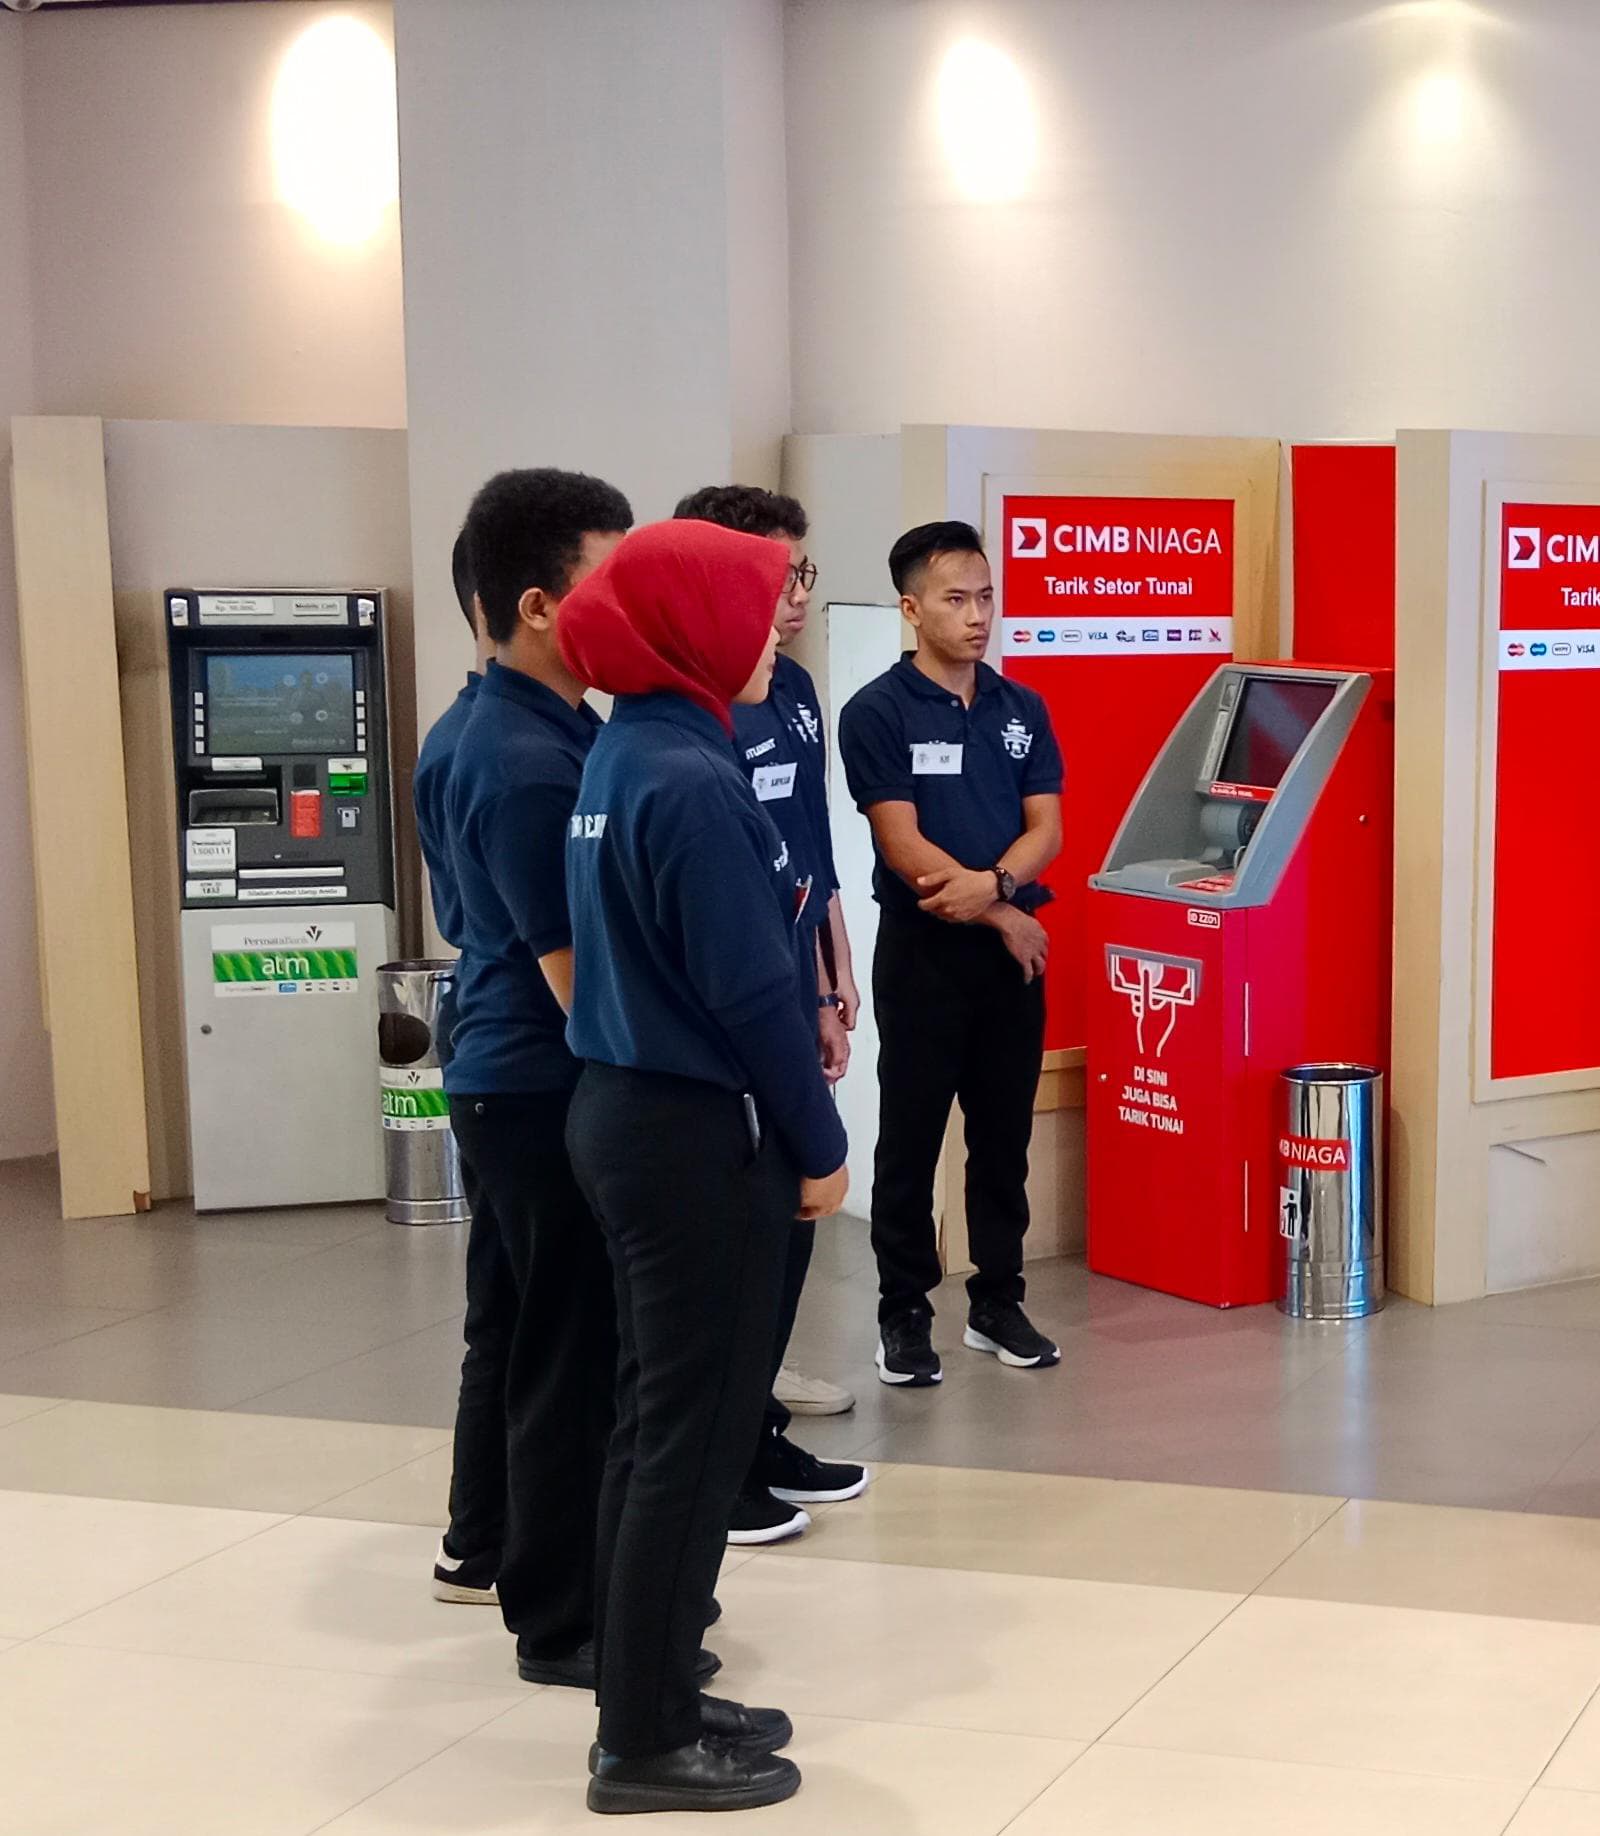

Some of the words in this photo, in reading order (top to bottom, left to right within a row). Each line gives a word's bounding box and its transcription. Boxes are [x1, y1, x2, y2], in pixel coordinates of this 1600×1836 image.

[1053, 524, 1130, 552] CIMB
[1136, 527, 1222, 554] NIAGA
[1044, 576, 1089, 595] Tarik
[1093, 577, 1141, 595] Setor
[1145, 577, 1193, 595] Tunai
[1577, 644, 1595, 653] VISA
[261, 955, 310, 975] atm
[1134, 1065, 1145, 1082] DI
[1146, 1068, 1168, 1087] SINI
[1122, 1085, 1151, 1106] JUGA
[1152, 1091, 1178, 1112] BISA
[1118, 1105, 1150, 1127] TARIK
[1150, 1113, 1184, 1135] TUNAI
[1291, 1141, 1346, 1166] NIAGA
